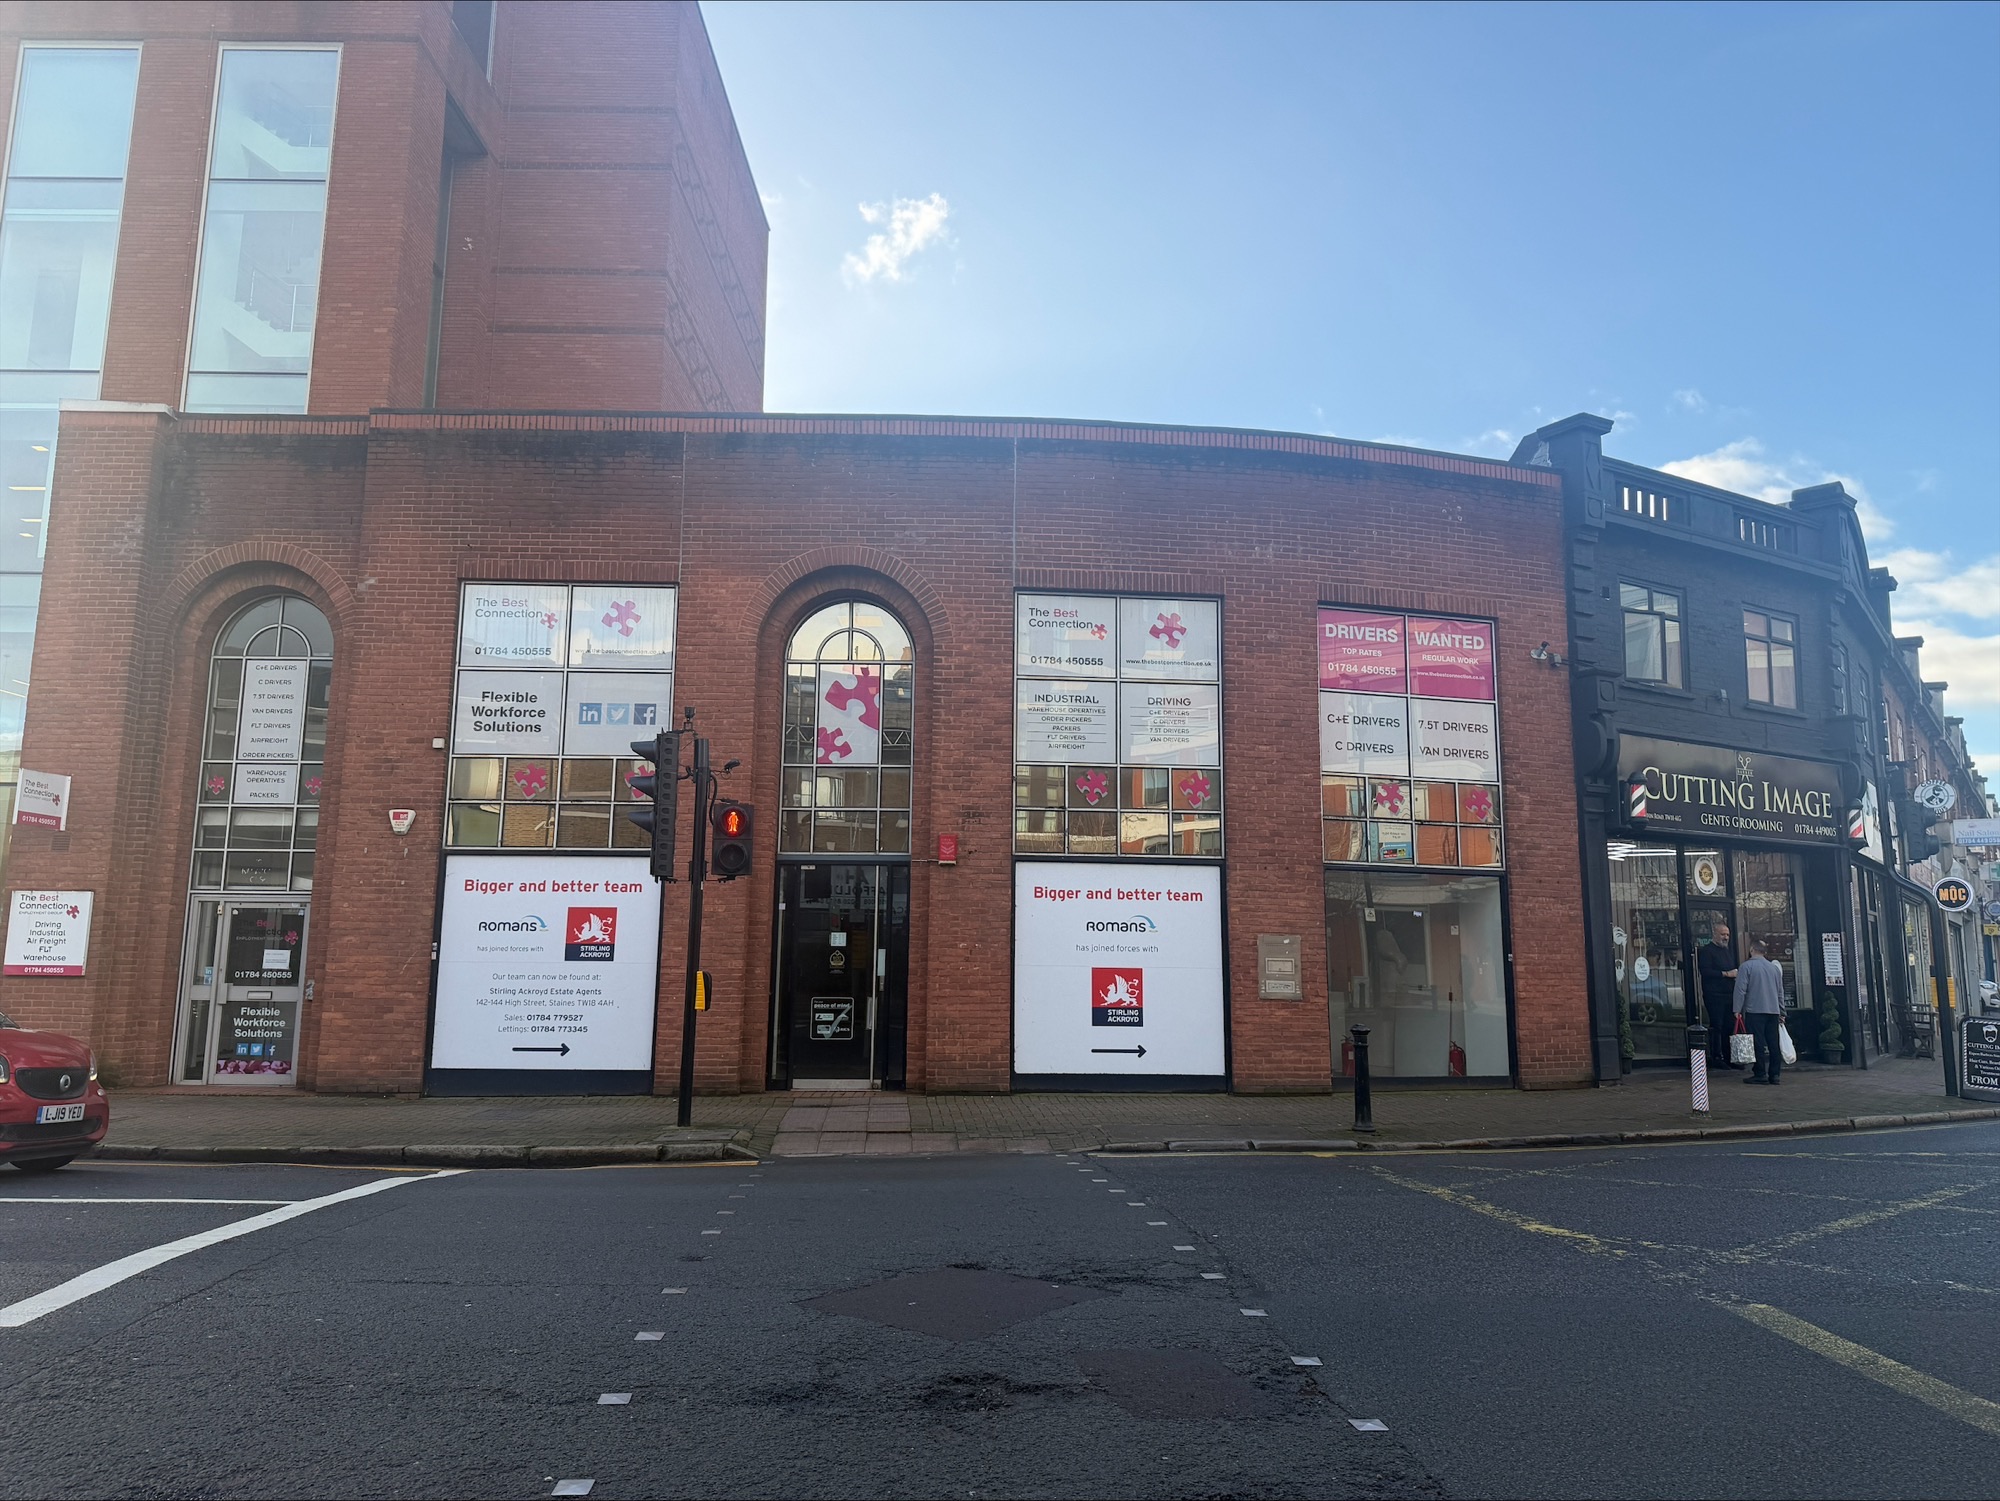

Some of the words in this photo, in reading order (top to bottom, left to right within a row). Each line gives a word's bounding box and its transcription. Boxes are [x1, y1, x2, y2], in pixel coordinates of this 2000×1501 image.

[476, 598, 497, 607] The
[502, 598, 528, 607] Best
[475, 609, 543, 618] Connection
[1029, 608, 1049, 616] The
[1054, 609, 1078, 617] Best
[1029, 618, 1093, 629] Connection
[1325, 624, 1398, 643] DRIVERS
[1415, 631, 1484, 649] WANTED
[475, 647, 508, 655] 01784
[512, 647, 552, 655] 450555
[1359, 649, 1382, 657] RATES
[1031, 656, 1062, 664] 01784
[1065, 657, 1103, 665] 450555
[1422, 654, 1456, 663] REGULAR
[1458, 656, 1479, 664] WORK
[1328, 663, 1358, 673] 01784
[1361, 664, 1396, 675] 450555
[482, 691, 538, 703] Flexible
[1034, 694, 1099, 704] INDUSTRIAL
[1148, 697, 1191, 706] DRIVING
[472, 706, 546, 718] Workforce
[1327, 714, 1349, 724] C+E
[1353, 716, 1400, 727] DRIVERS
[473, 721, 541, 732] Solutions
[1418, 720, 1439, 730] 7.5T
[1443, 722, 1488, 733] DRIVERS
[1335, 741, 1343, 750] C
[1347, 742, 1394, 753] DRIVERS
[1420, 746, 1439, 756] VAN
[1444, 748, 1489, 759] DRIVERS
[26, 779, 35, 787] The
[37, 781, 49, 789] Best
[24, 787, 54, 797] Connection
[1642, 766, 1754, 810] CUTTING
[1762, 781, 1832, 818] IMAGE
[1701, 813, 1730, 827] GENTS
[1732, 816, 1783, 832] GROOMING
[1795, 823, 1814, 835] 01784
[1815, 825, 1837, 836] 449005
[464, 879, 513, 894] Bigger
[519, 880, 546, 892] and
[552, 880, 599, 892] better
[604, 881, 642, 892] team
[1034, 886, 1081, 901] Bigger
[1086, 888, 1111, 900] and
[1117, 888, 1161, 901] better
[1167, 889, 1202, 901] team
[20, 902, 68, 910] Connection
[35, 921, 61, 929] Driving
[39, 938, 66, 946] Freight
[489, 945, 508, 953] joined
[505, 999, 521, 1007] High
[241, 1007, 280, 1016] Flexible
[234, 1018, 285, 1027] Workforce
[235, 1029, 282, 1038] Solutions
[1968, 1042, 1993, 1050] CUTTING
[1971, 1075, 1998, 1085] FROM
[45, 1107, 66, 1120] LJ19
[67, 1106, 82, 1119] YED
